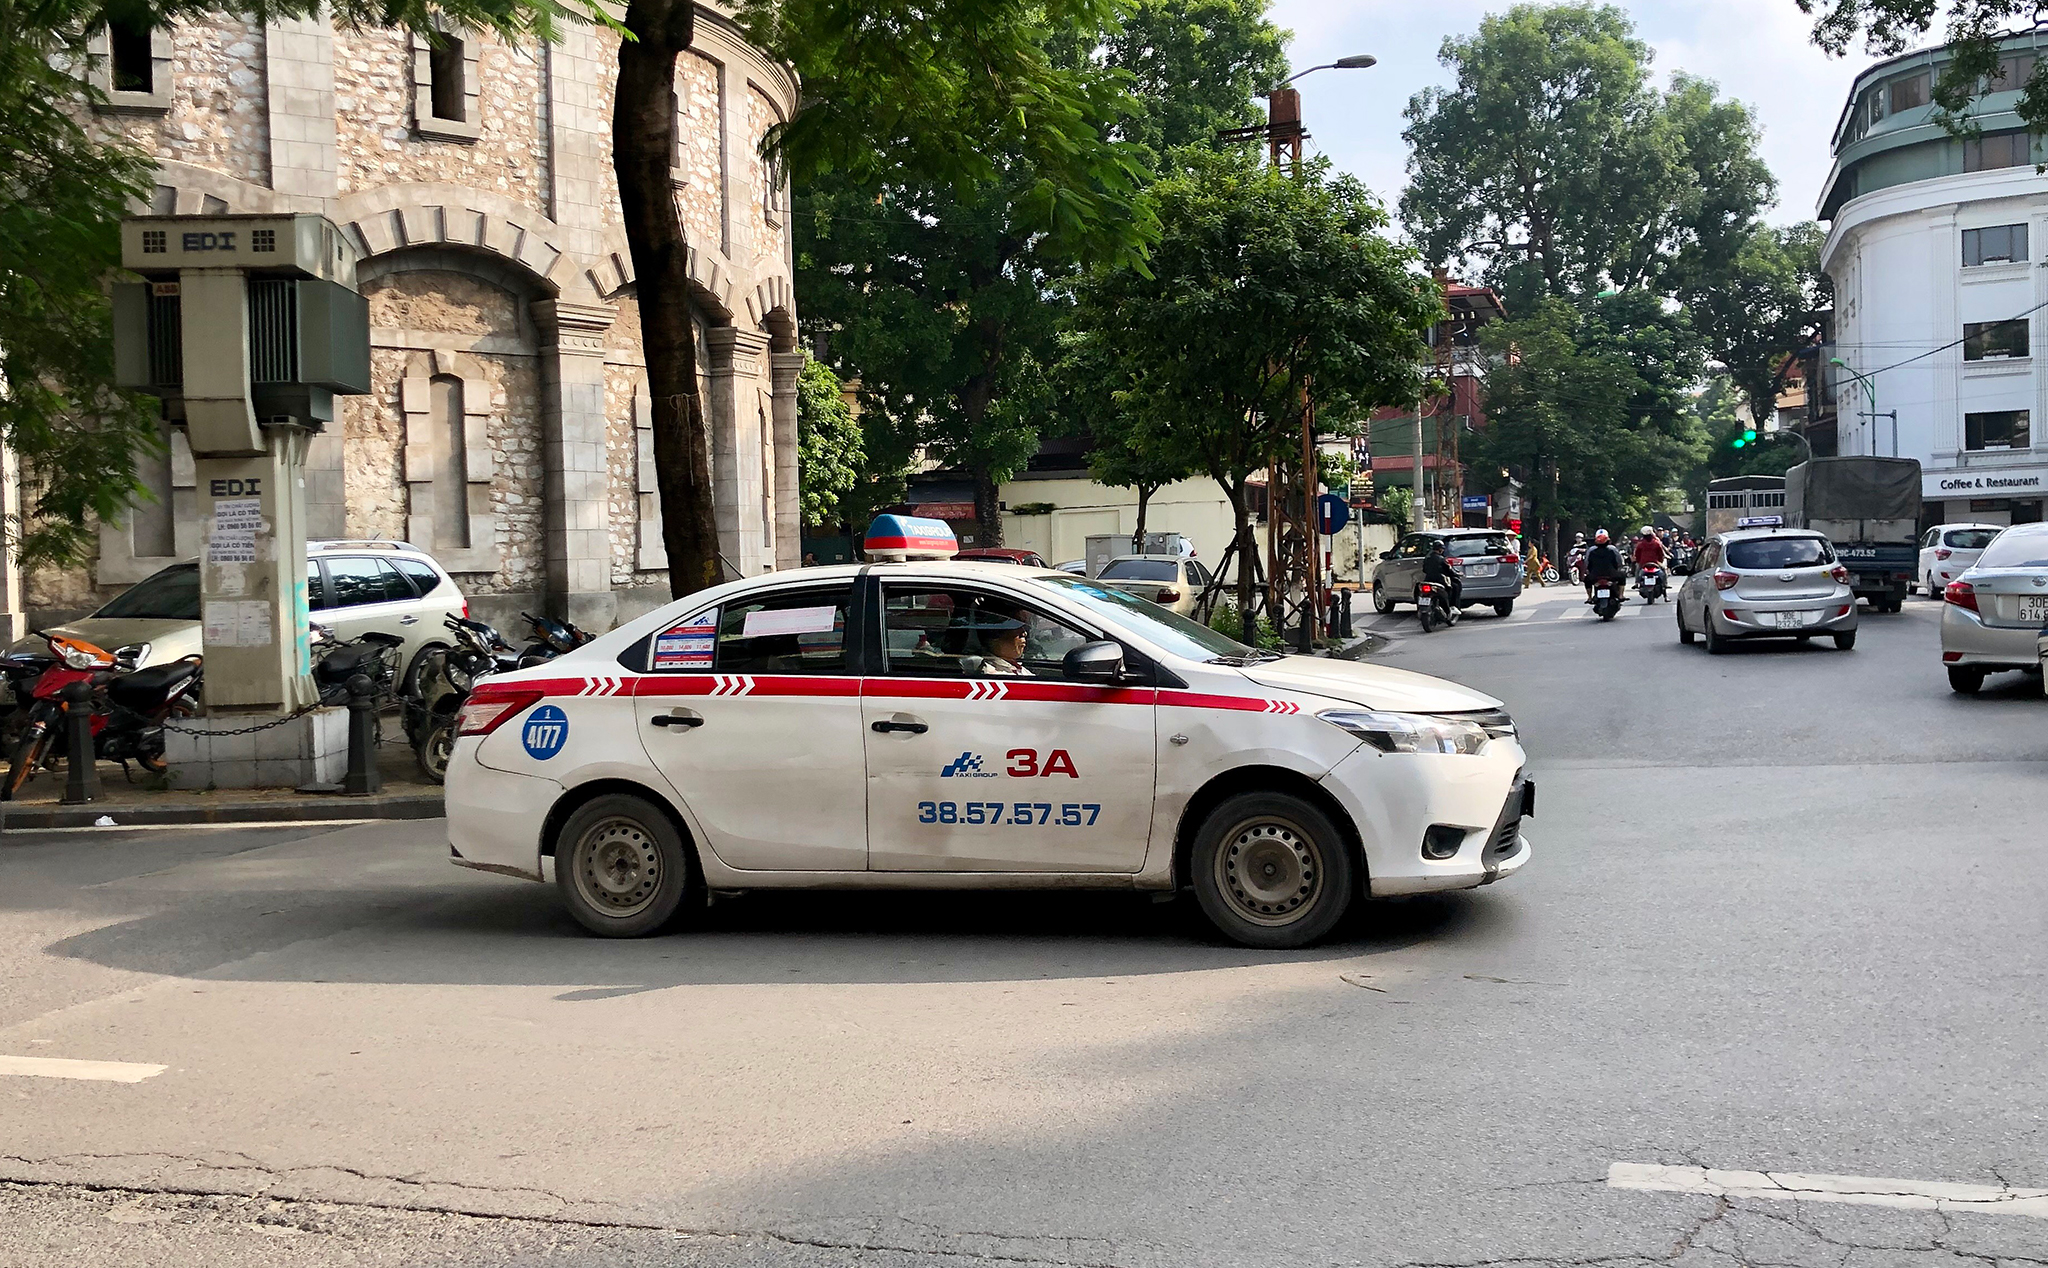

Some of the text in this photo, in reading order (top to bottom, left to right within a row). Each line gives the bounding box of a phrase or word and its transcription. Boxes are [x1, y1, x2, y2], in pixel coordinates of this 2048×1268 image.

[183, 232, 236, 251] EDI
[210, 478, 261, 496] EDI
[1940, 476, 2039, 490] Coffee & Restaurant
[1836, 549, 1876, 557] 29C-473.52
[2028, 597, 2048, 608] 30E
[544, 709, 551, 719] 1
[527, 725, 561, 749] 4177
[1006, 749, 1080, 778] 3A
[918, 802, 1101, 826] 38.57.57.57
